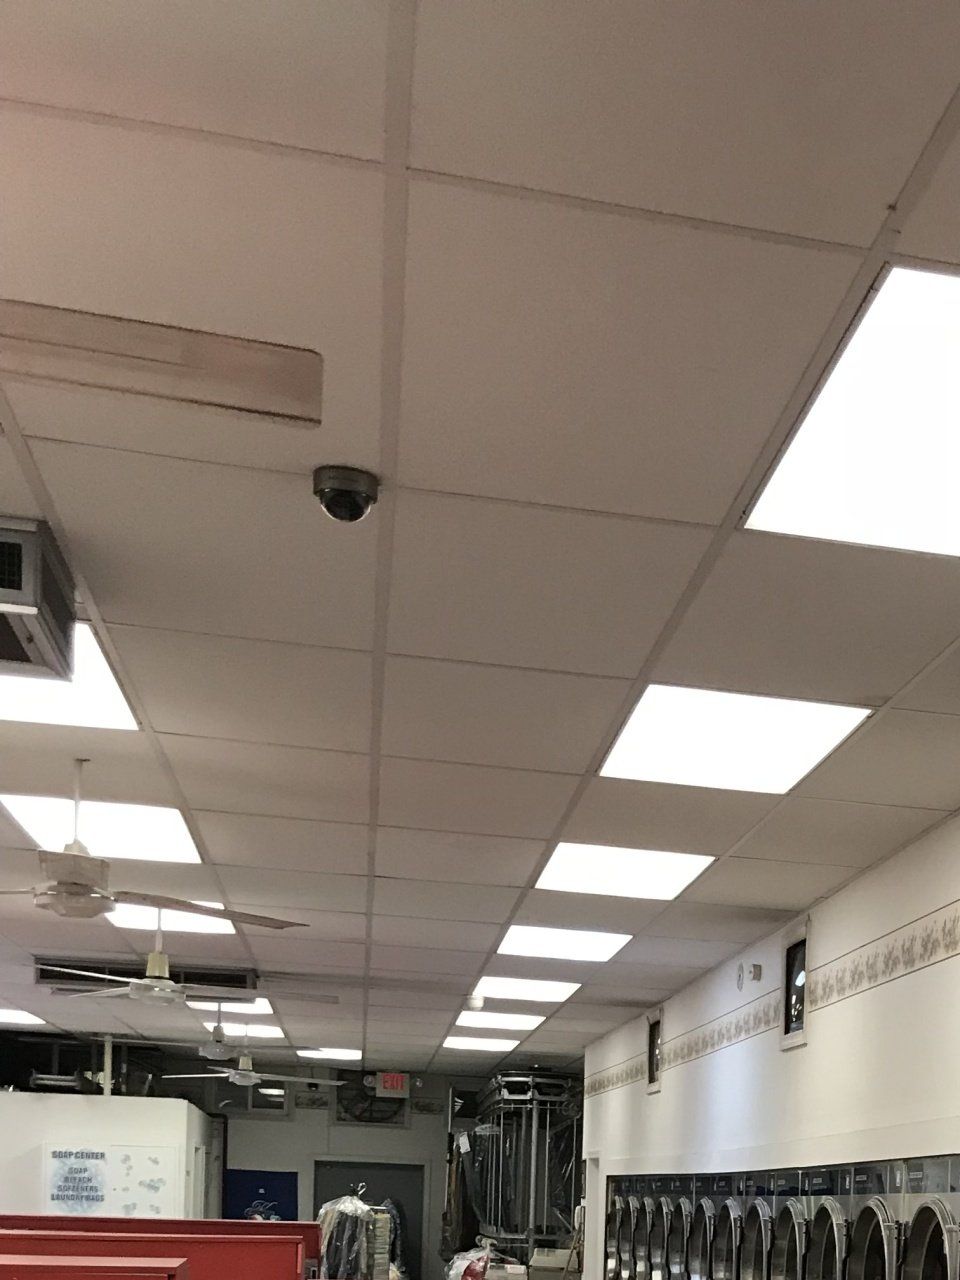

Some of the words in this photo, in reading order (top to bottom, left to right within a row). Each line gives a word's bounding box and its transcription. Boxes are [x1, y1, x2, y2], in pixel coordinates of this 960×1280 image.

[382, 1073, 405, 1089] EXIT
[51, 1150, 74, 1159] SOAP
[74, 1151, 105, 1160] CENTER
[67, 1167, 88, 1175] SOAP
